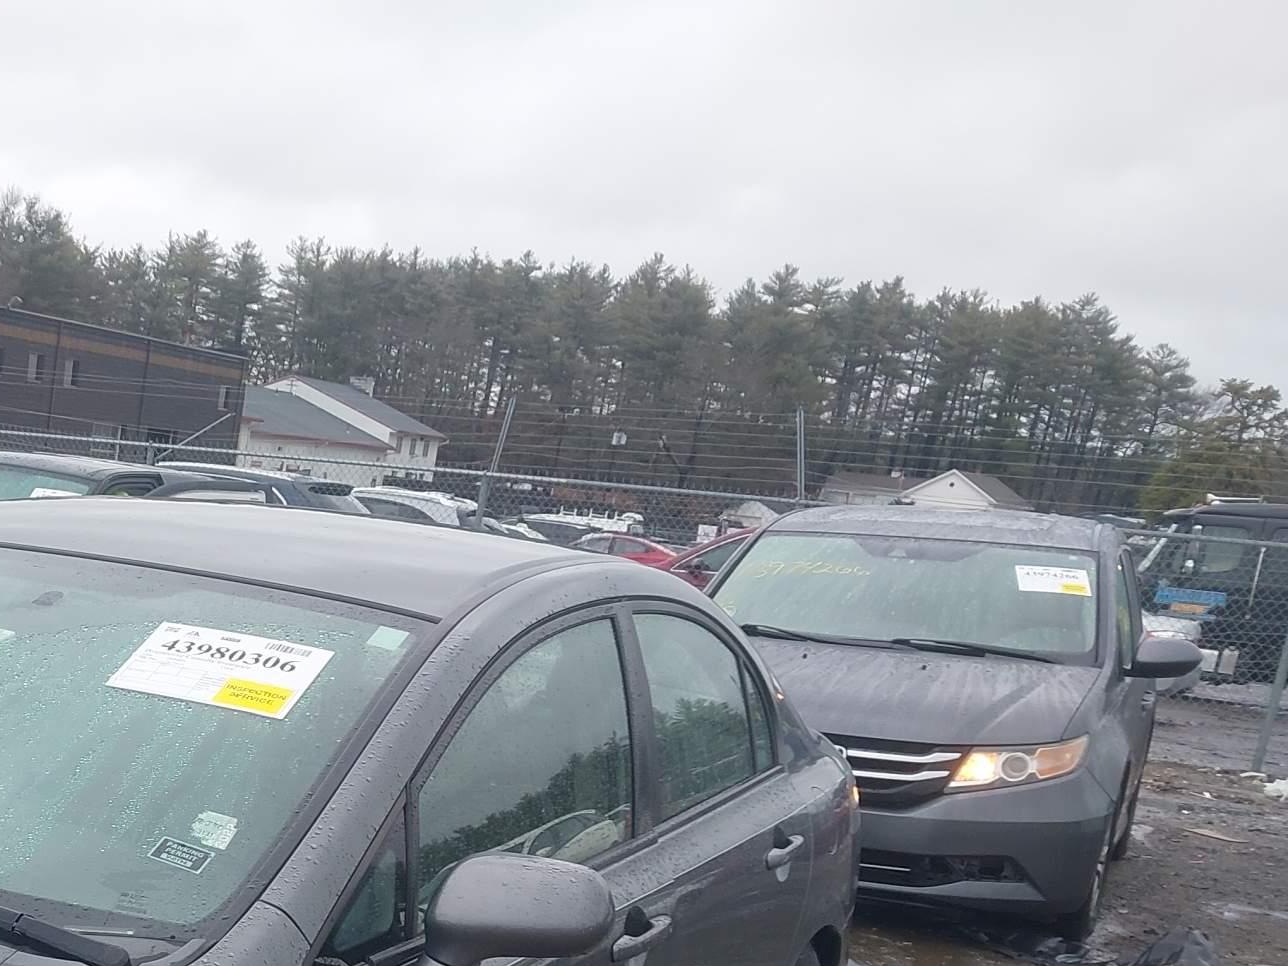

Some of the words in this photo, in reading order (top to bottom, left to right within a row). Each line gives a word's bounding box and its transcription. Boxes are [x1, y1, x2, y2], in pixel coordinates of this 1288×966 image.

[161, 639, 300, 673] 43980306
[226, 683, 288, 701] INSPECTION
[229, 691, 274, 706] SERVICE
[164, 847, 198, 862] PERMIT
[166, 841, 205, 858] PARKING
